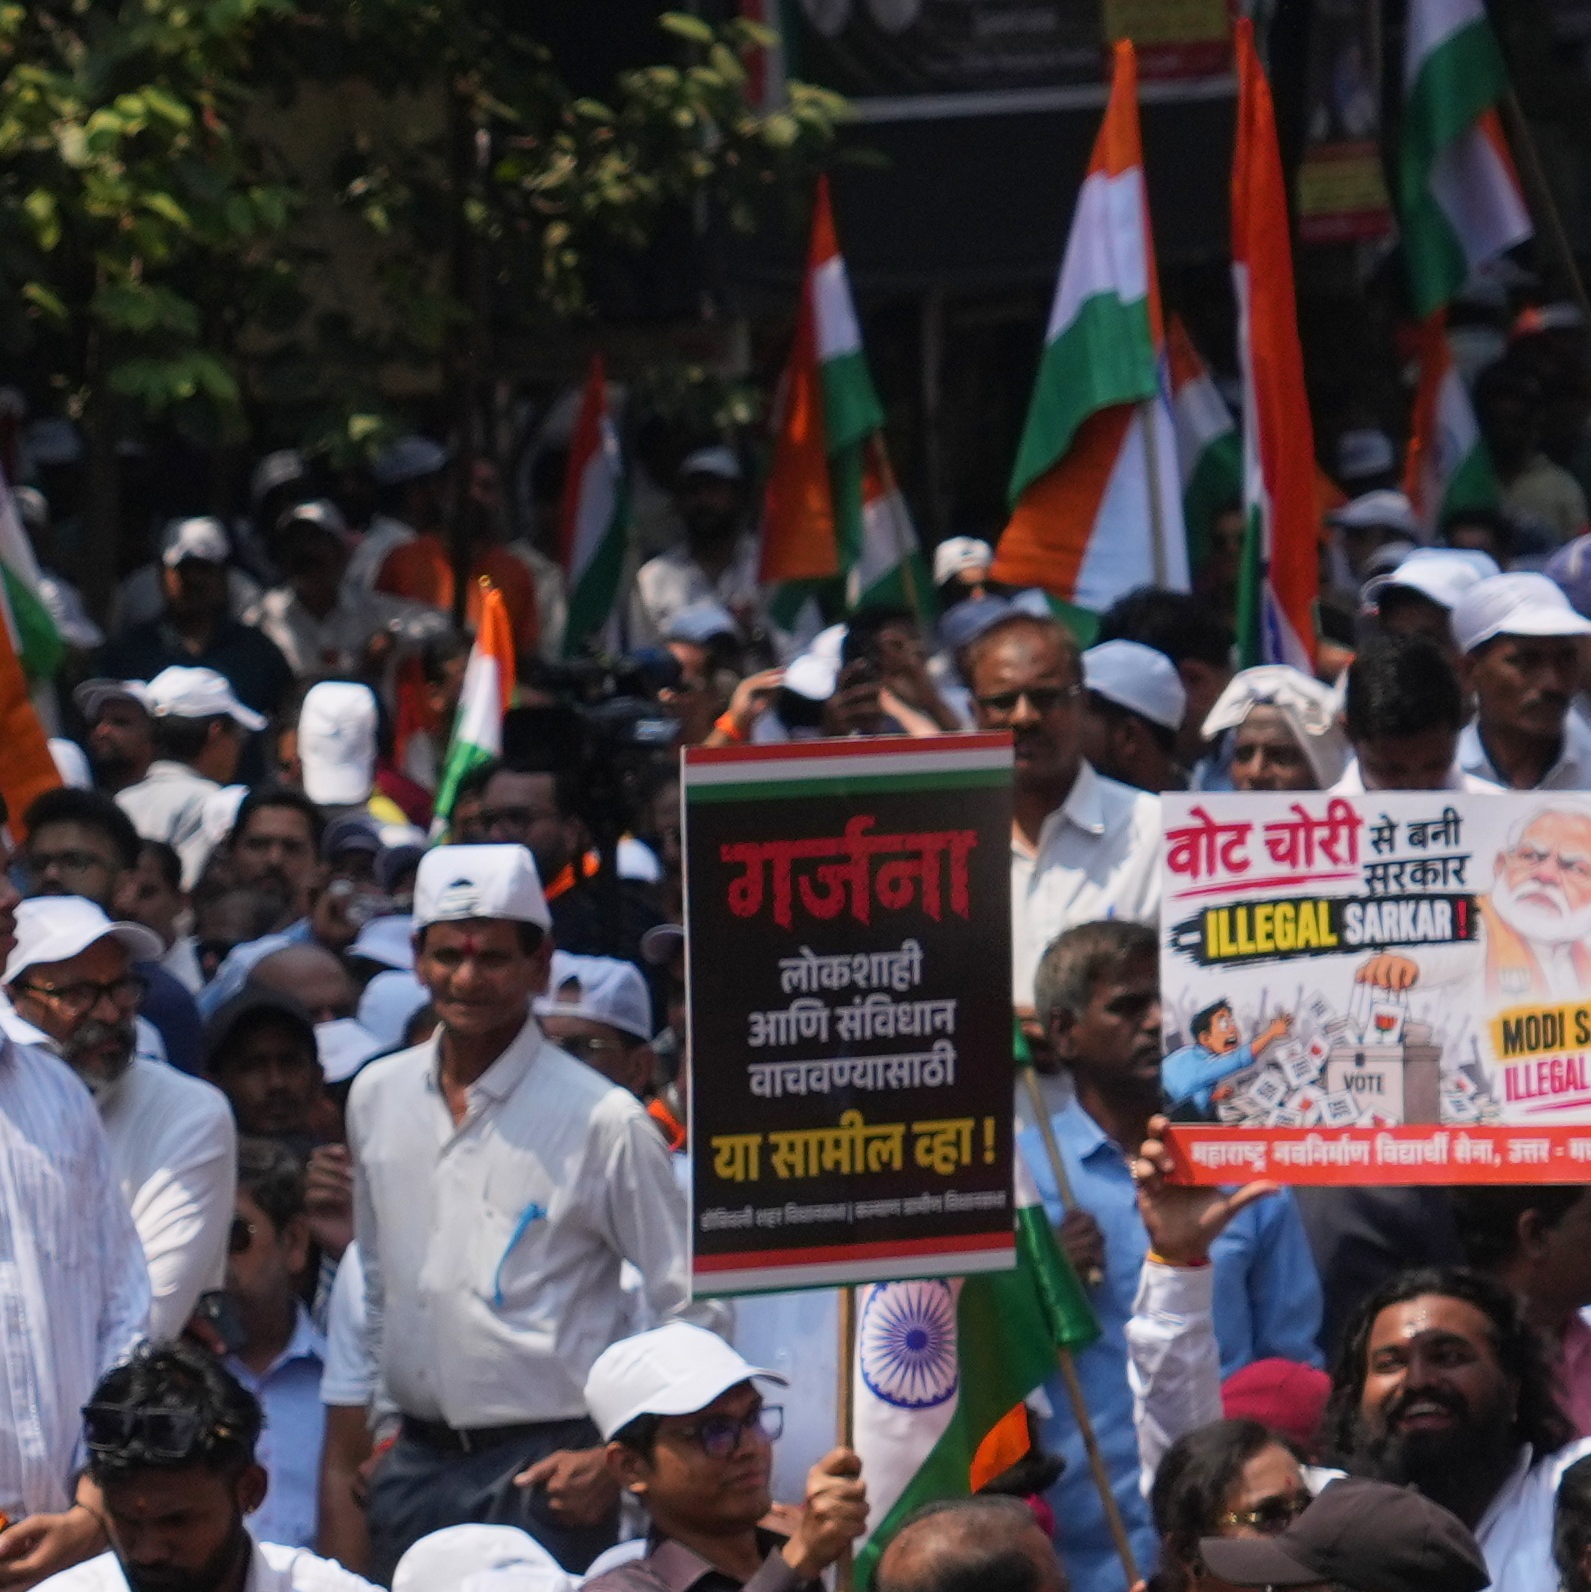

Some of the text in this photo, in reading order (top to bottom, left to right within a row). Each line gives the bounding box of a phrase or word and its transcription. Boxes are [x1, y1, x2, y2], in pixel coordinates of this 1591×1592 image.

[1166, 798, 1464, 880] वोट चोरी से बनी
[719, 814, 978, 933] गर्जना
[1363, 854, 1473, 897] सरकार
[1205, 900, 1338, 959] ILLEGAL
[778, 938, 923, 994] लोकशाही
[747, 992, 957, 1048] आणि संविधान
[1502, 1011, 1566, 1056] MODI
[747, 1038, 956, 1098] वाचवण्यासाठी
[1344, 1070, 1385, 1095] VOTE
[1505, 1056, 1591, 1102] ILLEGAL
[711, 1133, 762, 1182] या
[769, 1109, 906, 1179] सामील
[1191, 1140, 1267, 1173] महाराष्ट्र
[1273, 1132, 1370, 1167] नवनिर्माण
